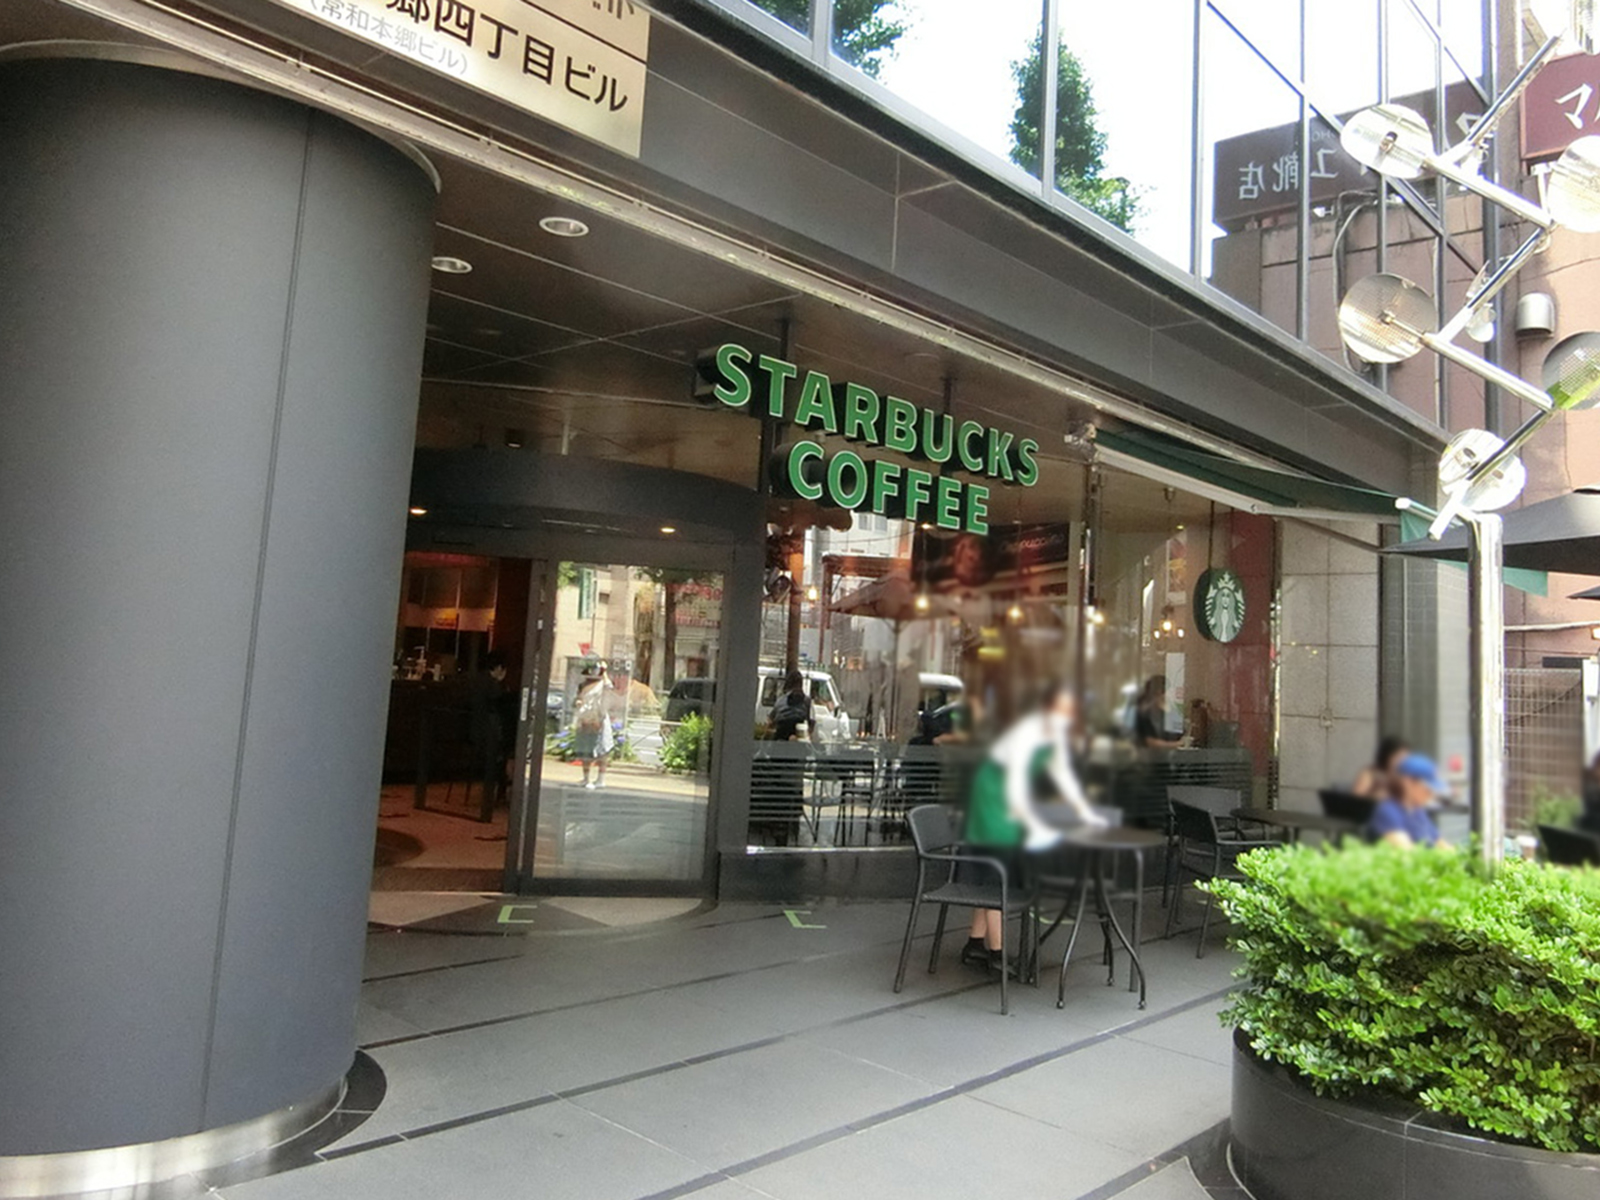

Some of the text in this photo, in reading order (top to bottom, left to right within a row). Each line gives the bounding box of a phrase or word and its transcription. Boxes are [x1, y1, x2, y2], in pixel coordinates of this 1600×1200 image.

[1554, 82, 1600, 129] マ
[713, 343, 1039, 486] STARBUCKS
[788, 441, 990, 536] COFFEE
